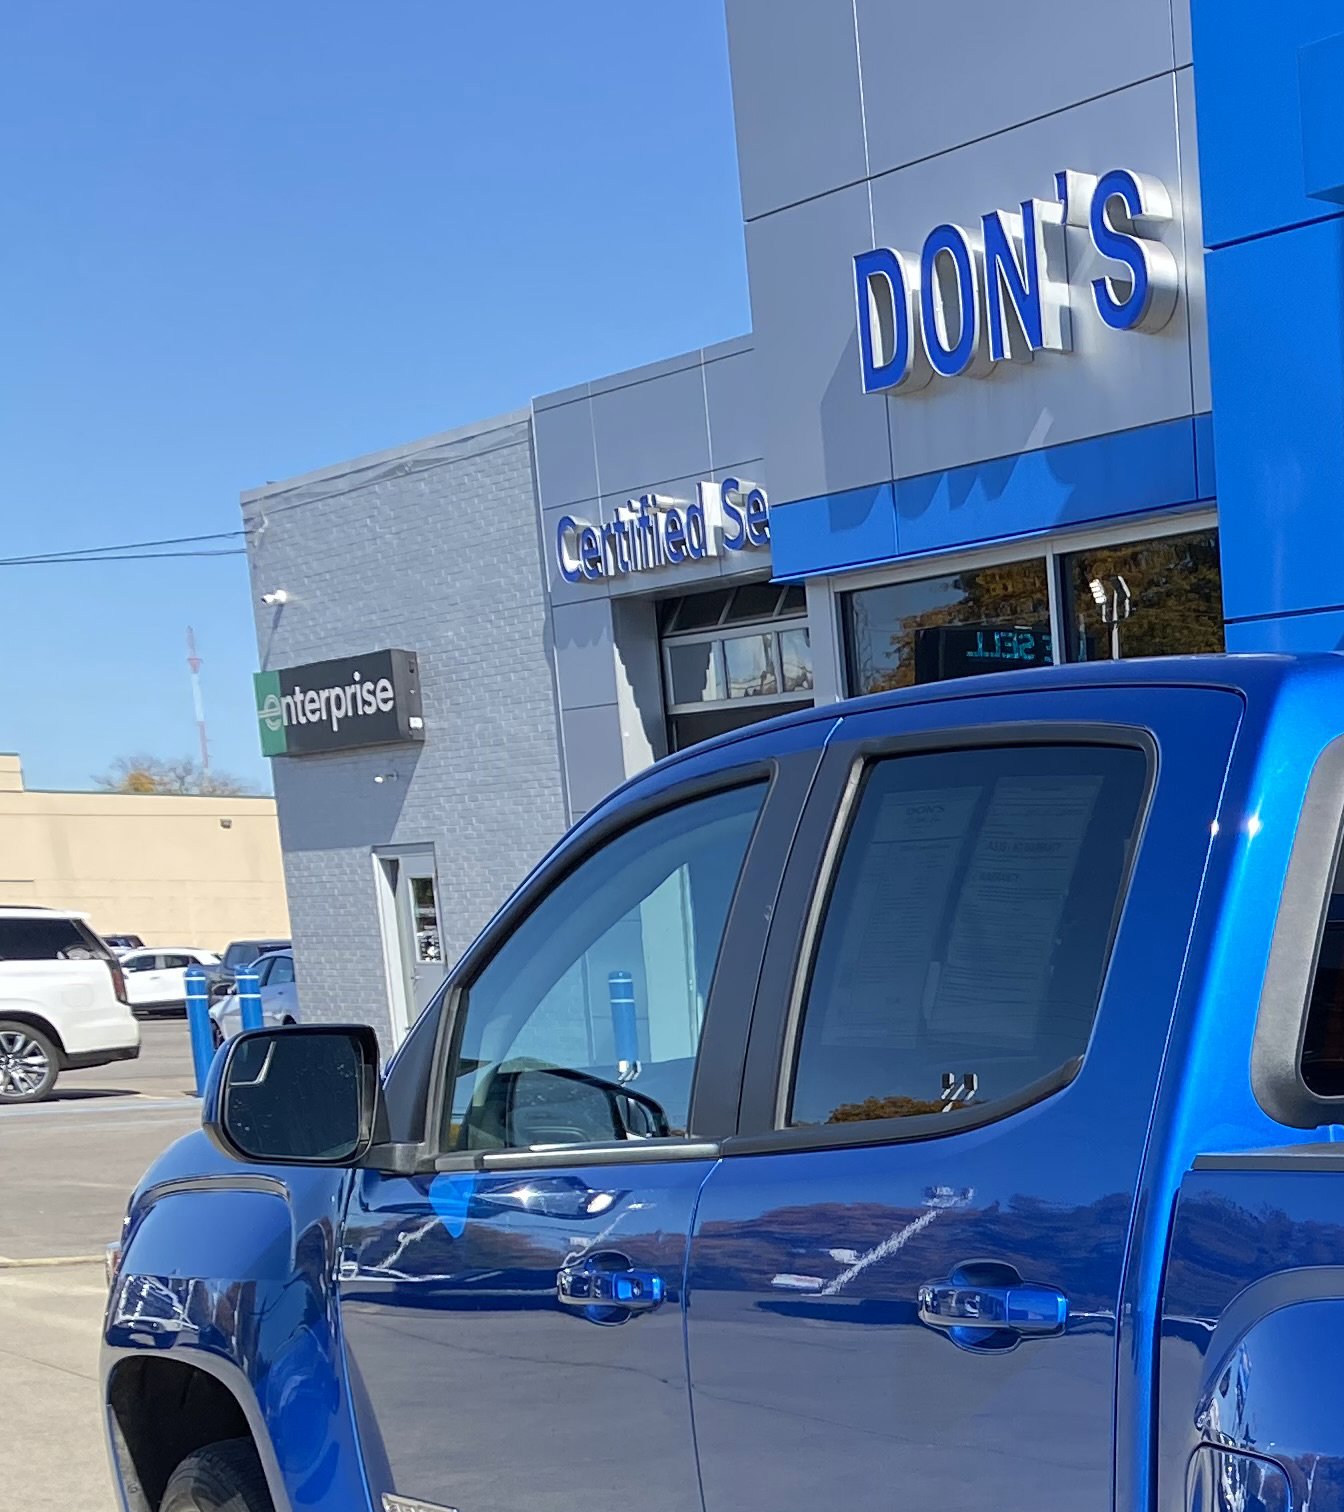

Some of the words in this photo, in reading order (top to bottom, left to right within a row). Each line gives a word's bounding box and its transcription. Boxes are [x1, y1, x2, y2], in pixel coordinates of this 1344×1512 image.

[852, 168, 1172, 394] DON'S
[556, 481, 716, 584] Certified
[258, 671, 395, 732] enterprise
